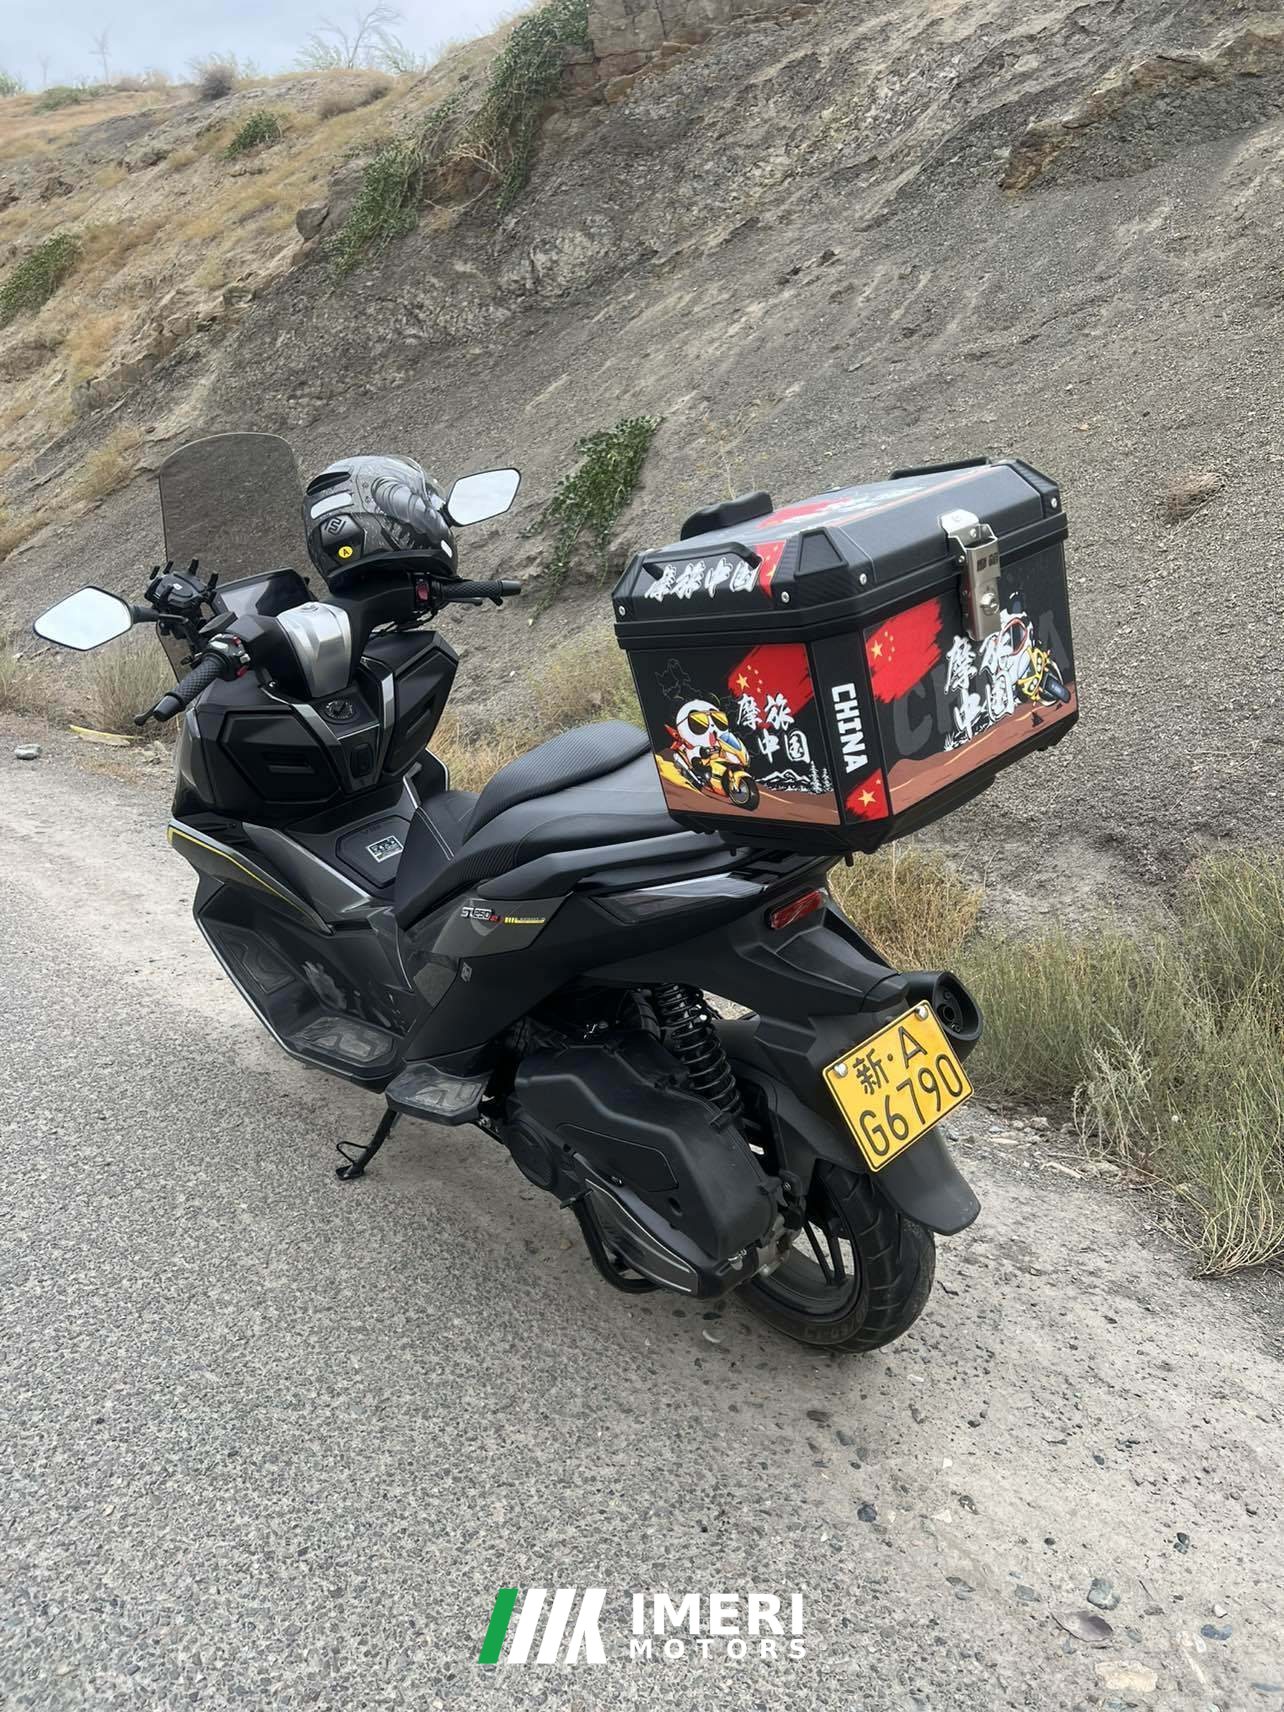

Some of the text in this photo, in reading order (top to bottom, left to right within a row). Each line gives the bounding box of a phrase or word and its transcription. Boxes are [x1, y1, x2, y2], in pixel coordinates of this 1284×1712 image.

[737, 693, 795, 730] 摩旅
[831, 682, 869, 774] CHINA
[757, 728, 811, 764] 中国
[859, 1053, 964, 1157] G6790
